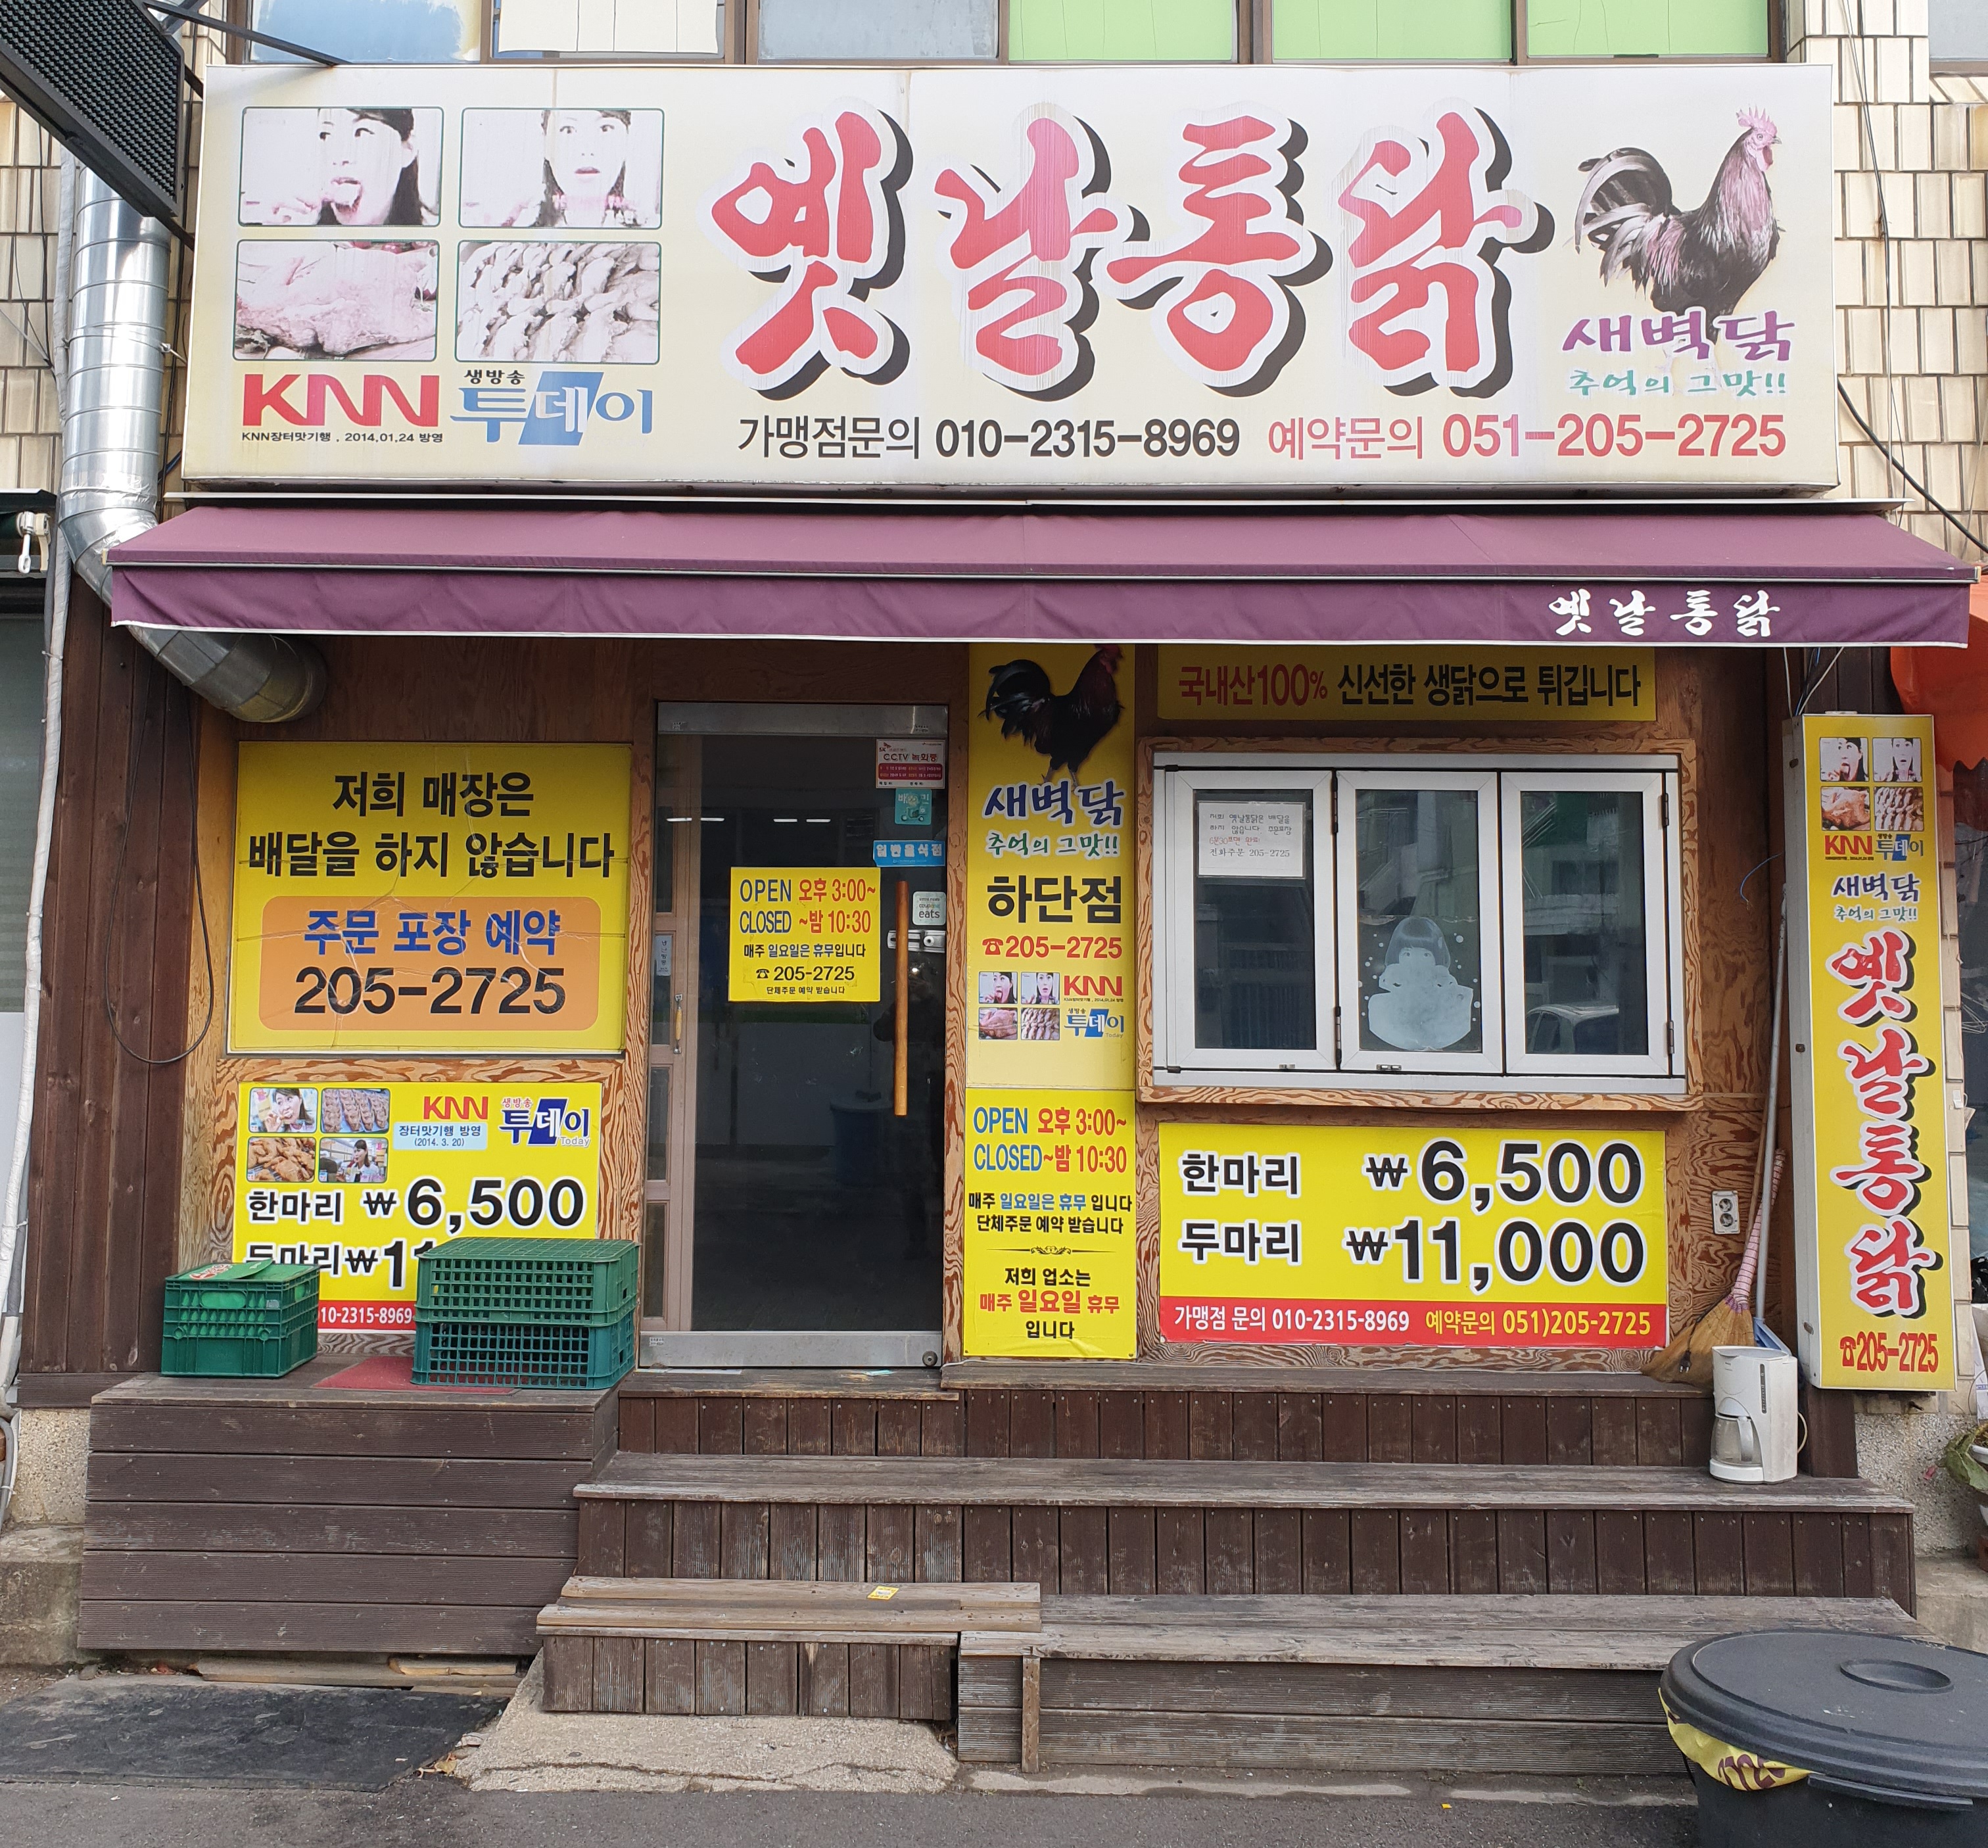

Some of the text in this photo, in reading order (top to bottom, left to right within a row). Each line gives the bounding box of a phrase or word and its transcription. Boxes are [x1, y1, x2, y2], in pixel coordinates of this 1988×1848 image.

[703, 105, 1542, 391] 옛날통닭
[1562, 310, 1795, 362] 새벽닭
[463, 369, 526, 385] 생방송
[1570, 369, 1787, 396] 추억의 그맛!!
[242, 373, 440, 427] KNN
[449, 381, 653, 444] 투데이
[241, 431, 331, 444] KNN장터맛기행
[419, 431, 444, 444] 방영
[738, 415, 1241, 460] 가맹점문의 010-2315-8969
[1267, 413, 1786, 461] 예약문의 051-205-2725
[1177, 663, 1642, 708] 국내산100% 신선한 생닭으로 튀깁니다
[883, 753, 909, 761] CCTV
[332, 771, 534, 818] 저희 매장은
[985, 781, 1124, 826] 새벽닭
[248, 831, 615, 878] 배달을 하지 않습니다
[988, 833, 1118, 857] 추억의 그맛!!
[1248, 849, 1290, 858] 205-2725
[1824, 835, 1873, 855] KNN
[1875, 838, 1924, 860] 투데이
[739, 878, 876, 903] OPEN 오후 3:00~
[987, 875, 1122, 924] 하단점
[1833, 872, 1921, 903] 새벽닭
[739, 910, 792, 934] CLOSED
[828, 910, 872, 934] 10:30
[918, 909, 940, 918] eats
[1834, 906, 1874, 921] 추억의
[304, 909, 561, 957] 주문 포장 예약
[744, 943, 866, 959] 매주 일요일은 휴무입니다
[1005, 936, 1123, 960] 205-2725
[773, 966, 855, 982] 205-2725
[1064, 975, 1122, 997] KNN
[294, 966, 565, 1015] 205-2725
[816, 986, 845, 995] 받습니다
[1064, 1013, 1124, 1037] 투데이
[423, 1096, 489, 1120] KNN
[501, 1097, 532, 1109] 생방송
[398, 1125, 481, 1137] 장터맛기행 방영
[498, 1106, 590, 1144] 투데이
[973, 1106, 1127, 1136] OPEN 오후 3:00~
[560, 1136, 591, 1147] Today
[974, 1143, 1043, 1172] CLOSED
[1077, 1145, 1127, 1173] 10:30
[1180, 1152, 1298, 1196] 한마리
[248, 1191, 342, 1223] 한마리
[968, 1192, 1133, 1212] 매주 일요일은 휴무 입니다
[977, 1214, 1124, 1234] 단체주문 예약 받습니다
[1181, 1221, 1300, 1263] 두마리
[1005, 1267, 1091, 1287] 저희 업소는
[980, 1289, 1120, 1314] 매주 일요일 휴무
[318, 1305, 412, 1325] 10-2315-8969
[1173, 1305, 1651, 1337] 가맹점 문의 010-2315-8969 예약문의 051)205-2725
[1026, 1320, 1076, 1339] 입니다
[1856, 1331, 1939, 1373] 205-2725
